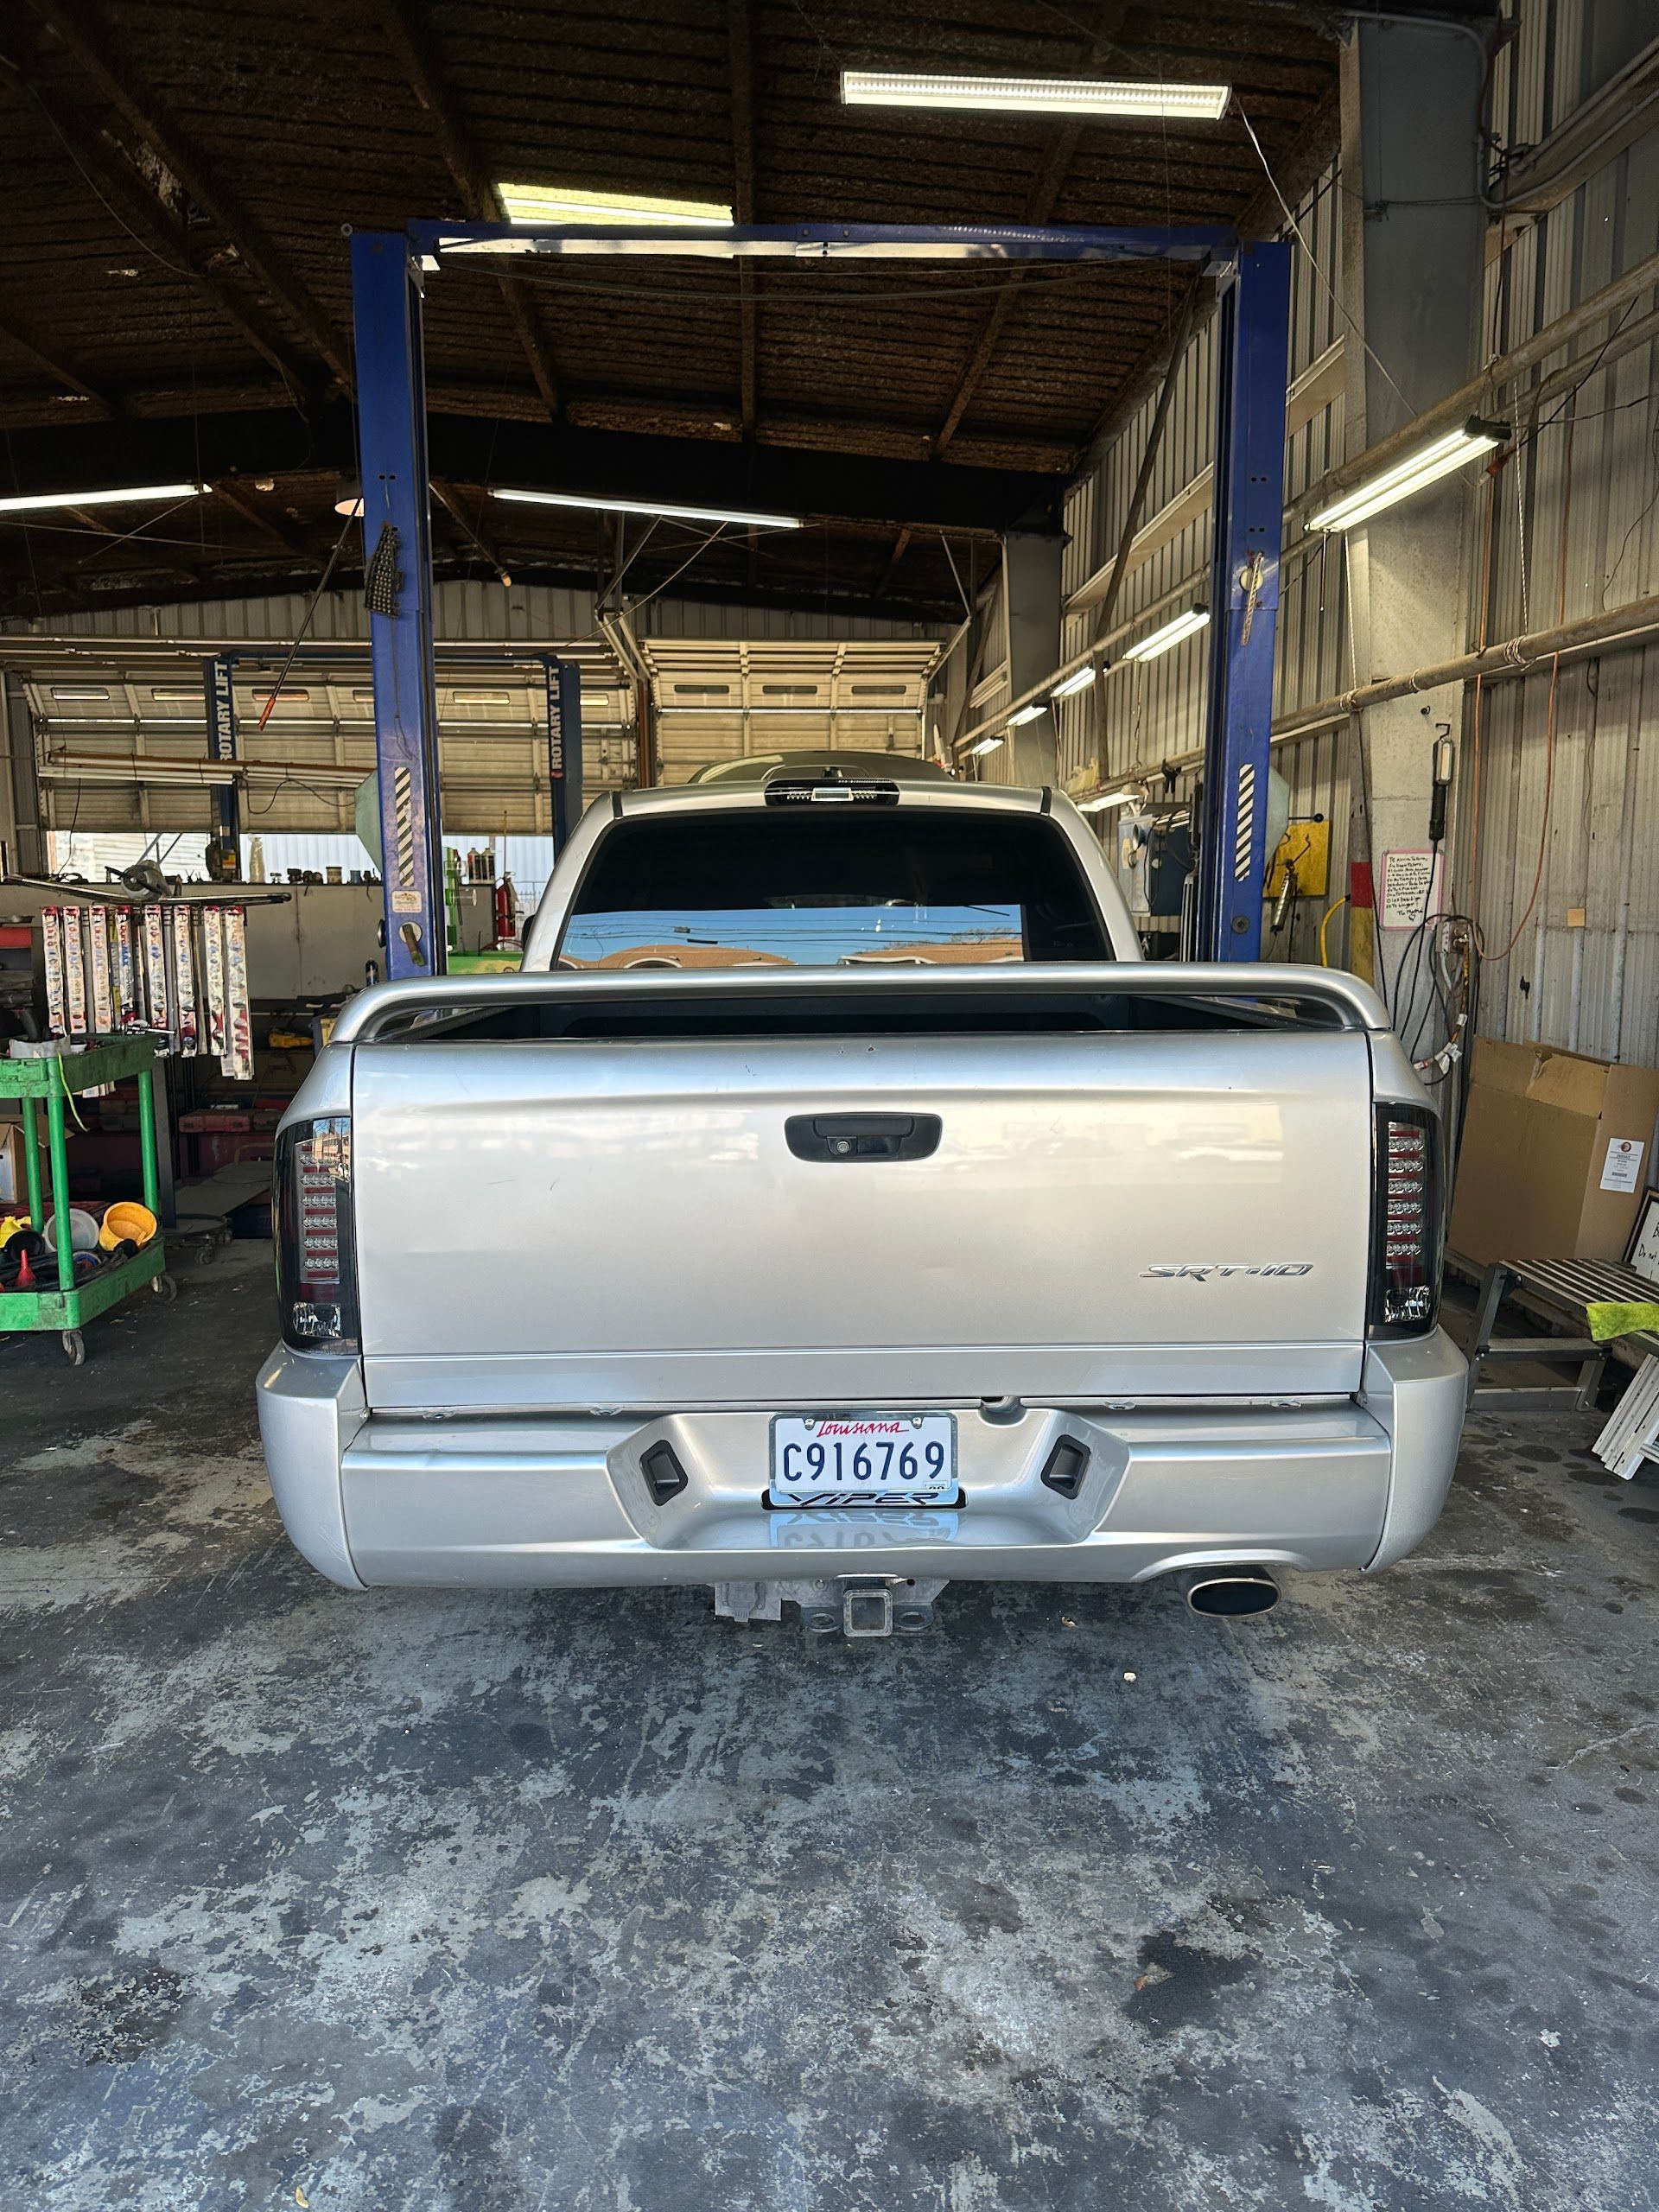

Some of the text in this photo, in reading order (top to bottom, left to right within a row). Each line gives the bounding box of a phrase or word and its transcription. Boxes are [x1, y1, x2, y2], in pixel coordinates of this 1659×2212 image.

[214, 661, 230, 696] LIFT
[549, 665, 562, 769] ROTARY LIFT
[817, 1421, 909, 1438] Louisiana
[784, 1441, 944, 1481] C916769
[787, 1492, 939, 1506] VIPER
